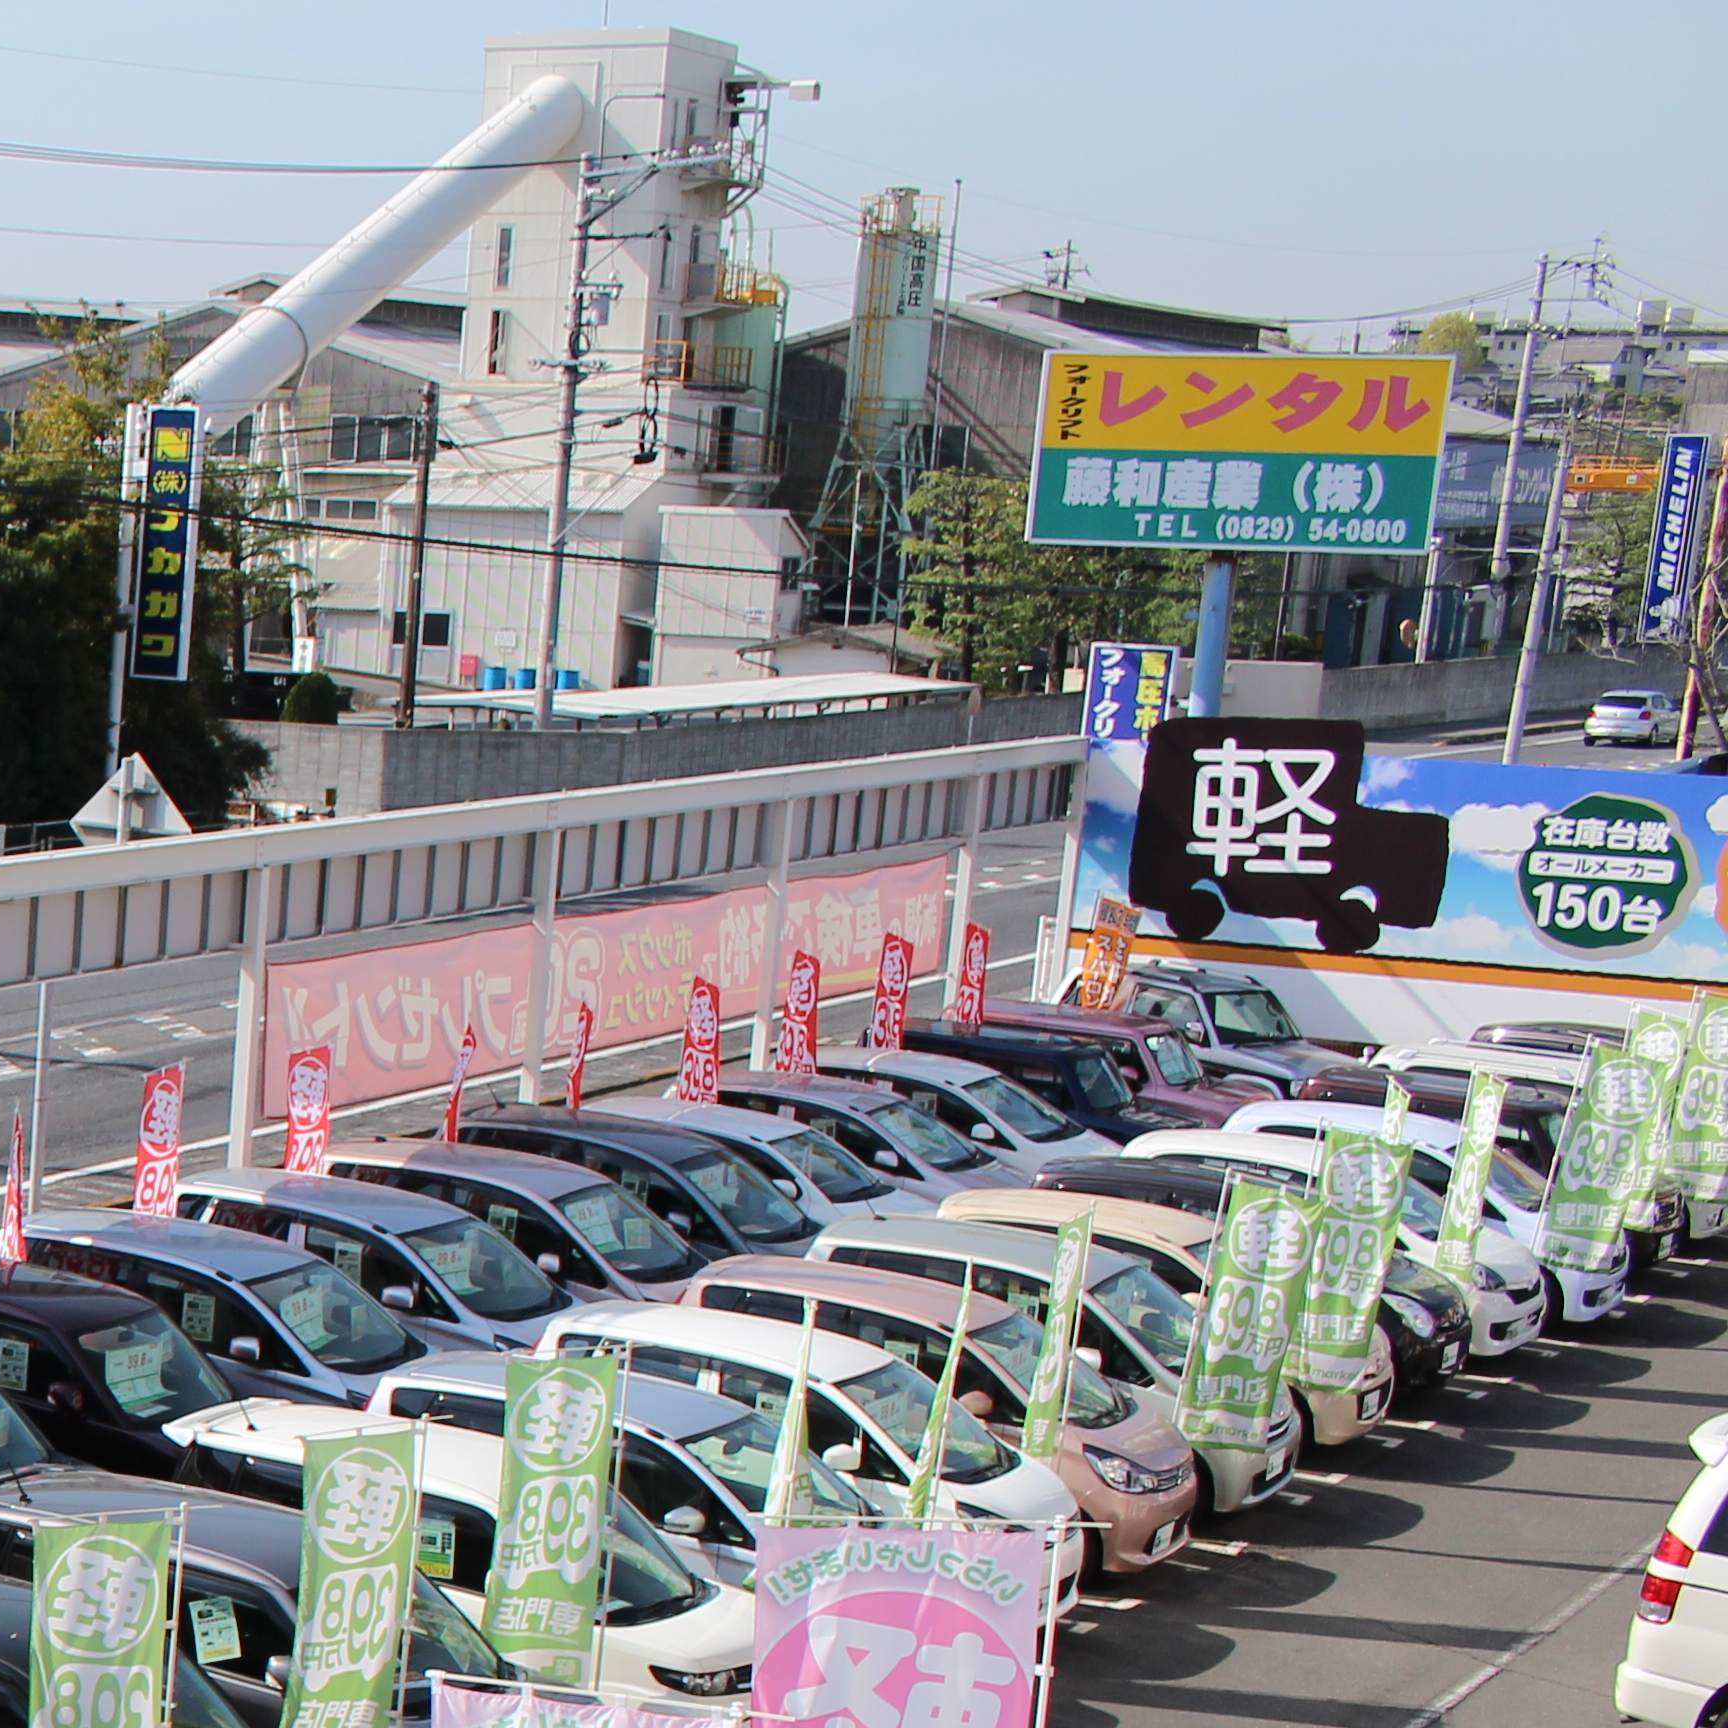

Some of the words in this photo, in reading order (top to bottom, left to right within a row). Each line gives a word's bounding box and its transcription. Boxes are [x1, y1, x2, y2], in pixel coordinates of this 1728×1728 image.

[908, 236, 927, 307] 中国高圧
[1059, 363, 1089, 440] フォークリフト
[1099, 370, 1431, 434] レンタル
[1062, 457, 1263, 512] 藤和産業
[1215, 515, 1295, 542] (0829)
[1308, 518, 1407, 544] 54-0800
[1656, 447, 1695, 592] MICHELIN
[1093, 649, 1126, 739] フォークリ
[1186, 738, 1336, 877] 軽
[1543, 816, 1670, 853] 在庫台数
[1537, 857, 1666, 880] オールメーカー
[1530, 882, 1663, 935] 150台
[1594, 1066, 1656, 1120] 軽
[1333, 1152, 1394, 1211] 軽
[1236, 1209, 1308, 1272] 軽
[1553, 1203, 1622, 1230] 専門店
[1296, 1311, 1368, 1340] 専門店
[1196, 1374, 1270, 1402] 専門店
